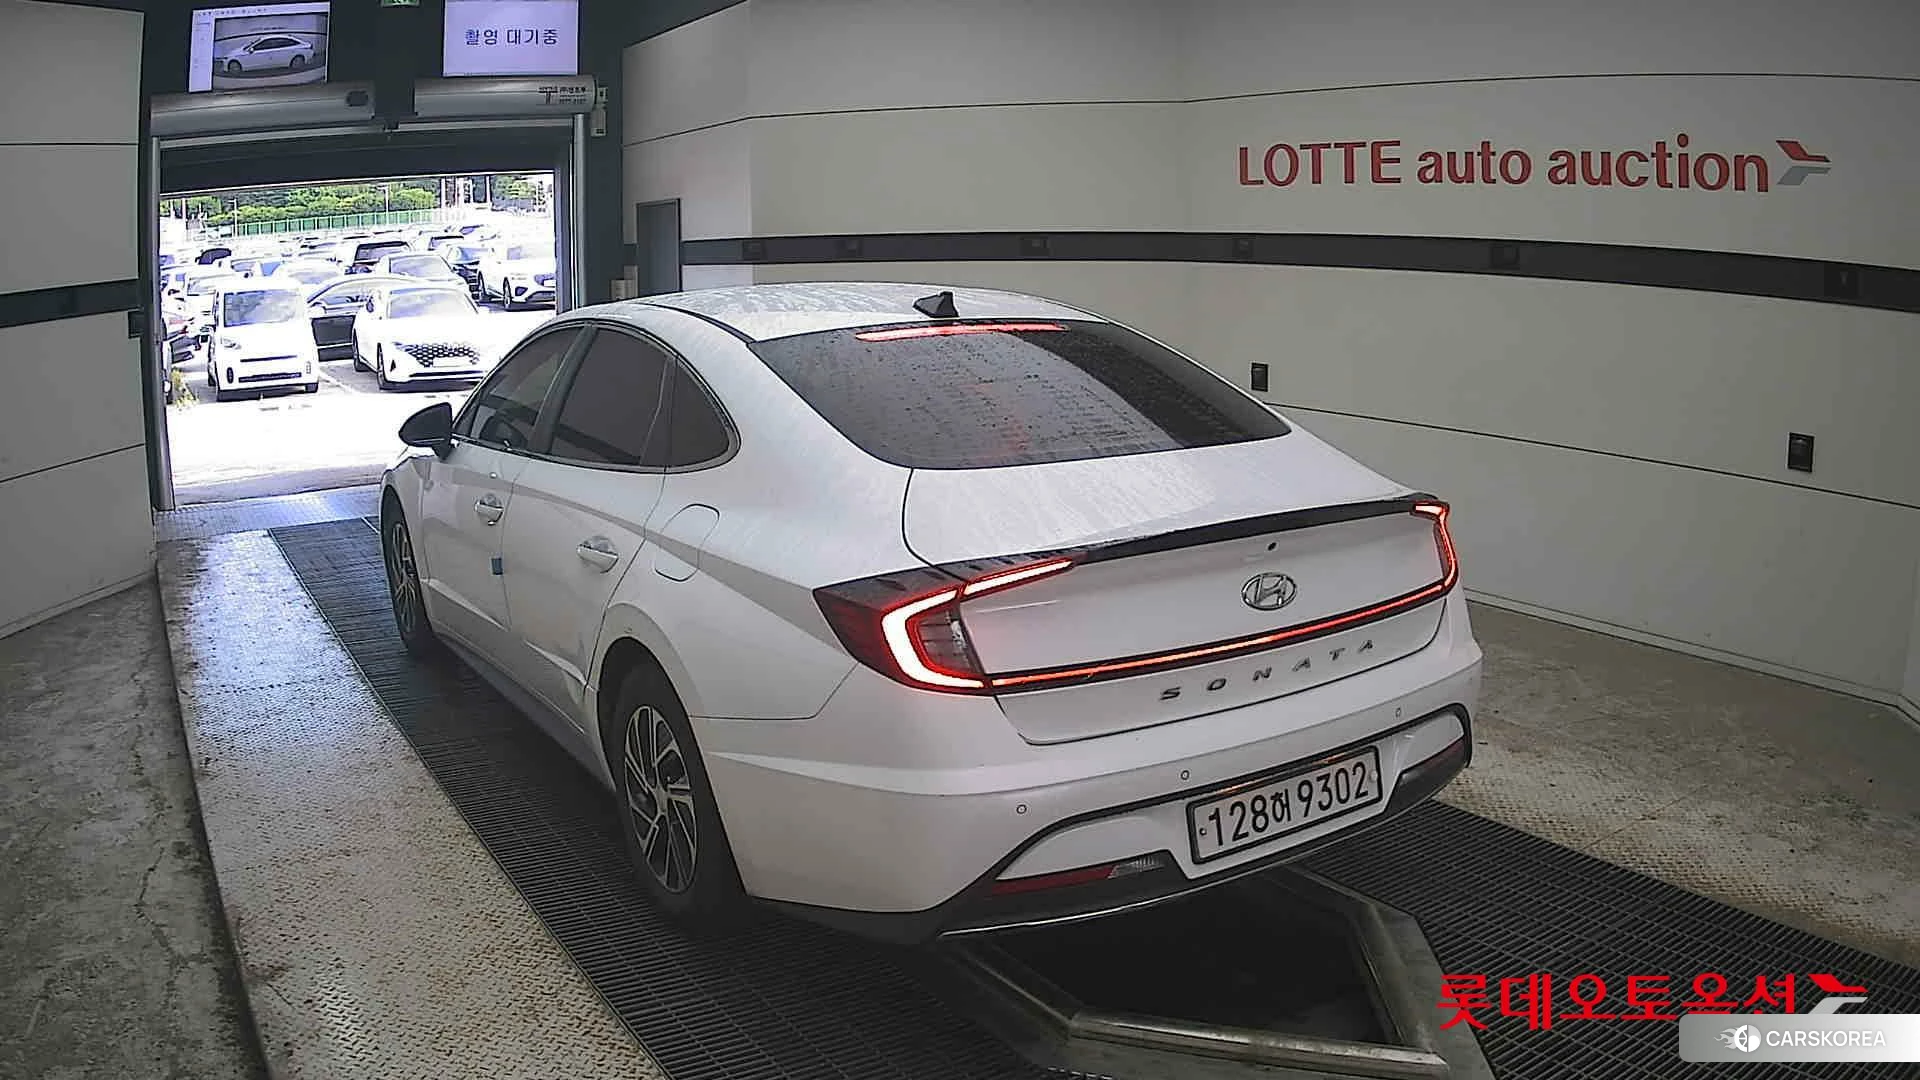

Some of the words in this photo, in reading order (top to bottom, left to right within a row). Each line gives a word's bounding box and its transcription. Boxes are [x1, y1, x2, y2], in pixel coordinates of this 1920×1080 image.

[465, 28, 498, 46] 촬영
[506, 28, 558, 46] 대기중
[1239, 140, 1401, 187] LOTTE
[1416, 141, 1532, 184] auto
[1549, 133, 1769, 193] auction
[1160, 639, 1375, 701] SONATA
